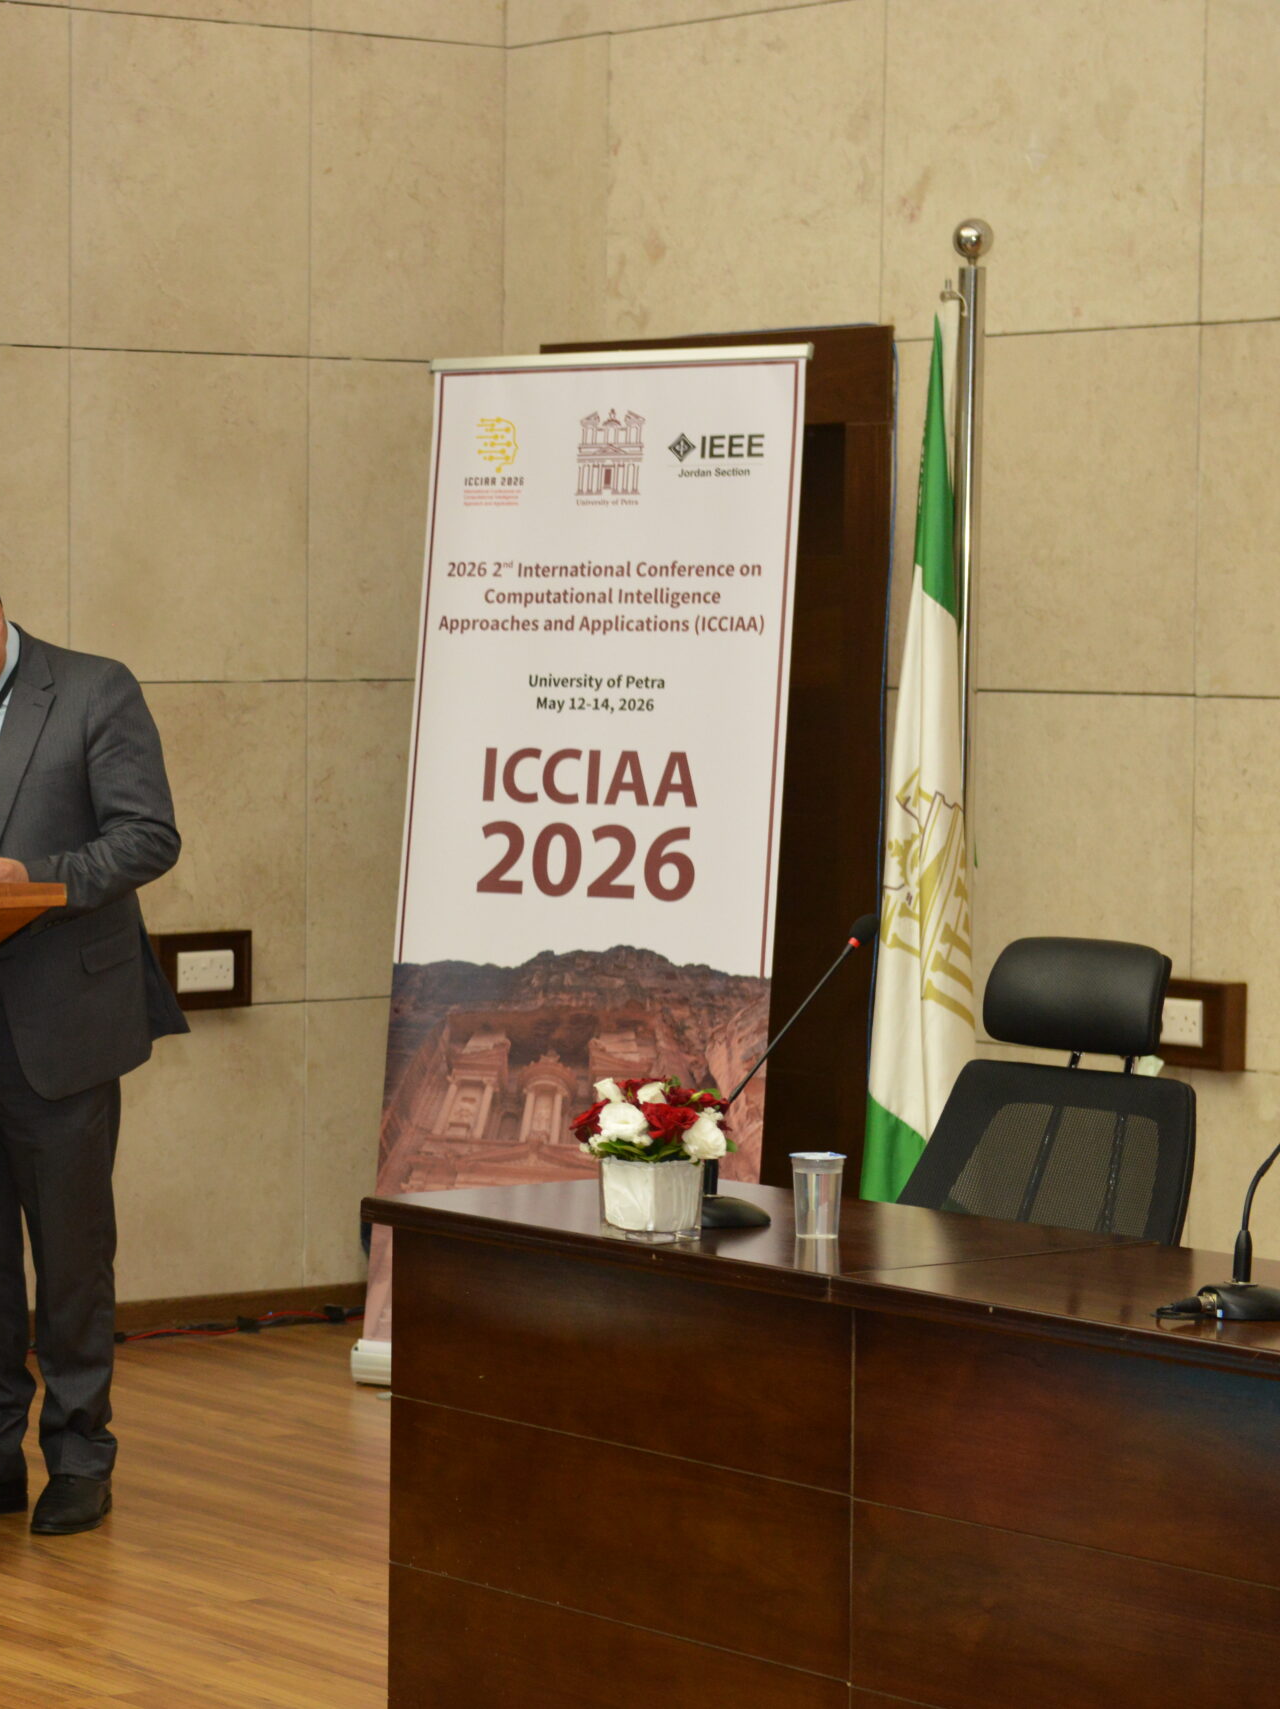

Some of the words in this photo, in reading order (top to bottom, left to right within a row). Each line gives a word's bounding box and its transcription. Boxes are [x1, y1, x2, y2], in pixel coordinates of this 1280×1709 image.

[700, 434, 765, 459] IEEE
[500, 476, 525, 487] 2026
[678, 468, 712, 478] Jordan
[714, 467, 751, 477] Section
[576, 498, 609, 508] University
[447, 562, 488, 577] 2026
[492, 560, 514, 577] 2nd
[518, 560, 631, 578] International
[636, 560, 735, 577] Conference
[740, 563, 762, 577] on
[484, 587, 613, 608] Computational
[618, 587, 721, 608] Intelligence
[438, 615, 539, 635] Approaches
[543, 615, 575, 632] and
[579, 615, 690, 636] Applications
[694, 615, 765, 636] (ICCIAA)
[528, 674, 603, 691] University
[607, 674, 623, 689] of
[626, 675, 666, 690] Petra
[536, 696, 565, 713] May
[569, 697, 615, 714] 12-14,
[619, 698, 655, 712] 2026
[482, 747, 698, 808] ICCIAA
[476, 820, 695, 902] 2026
